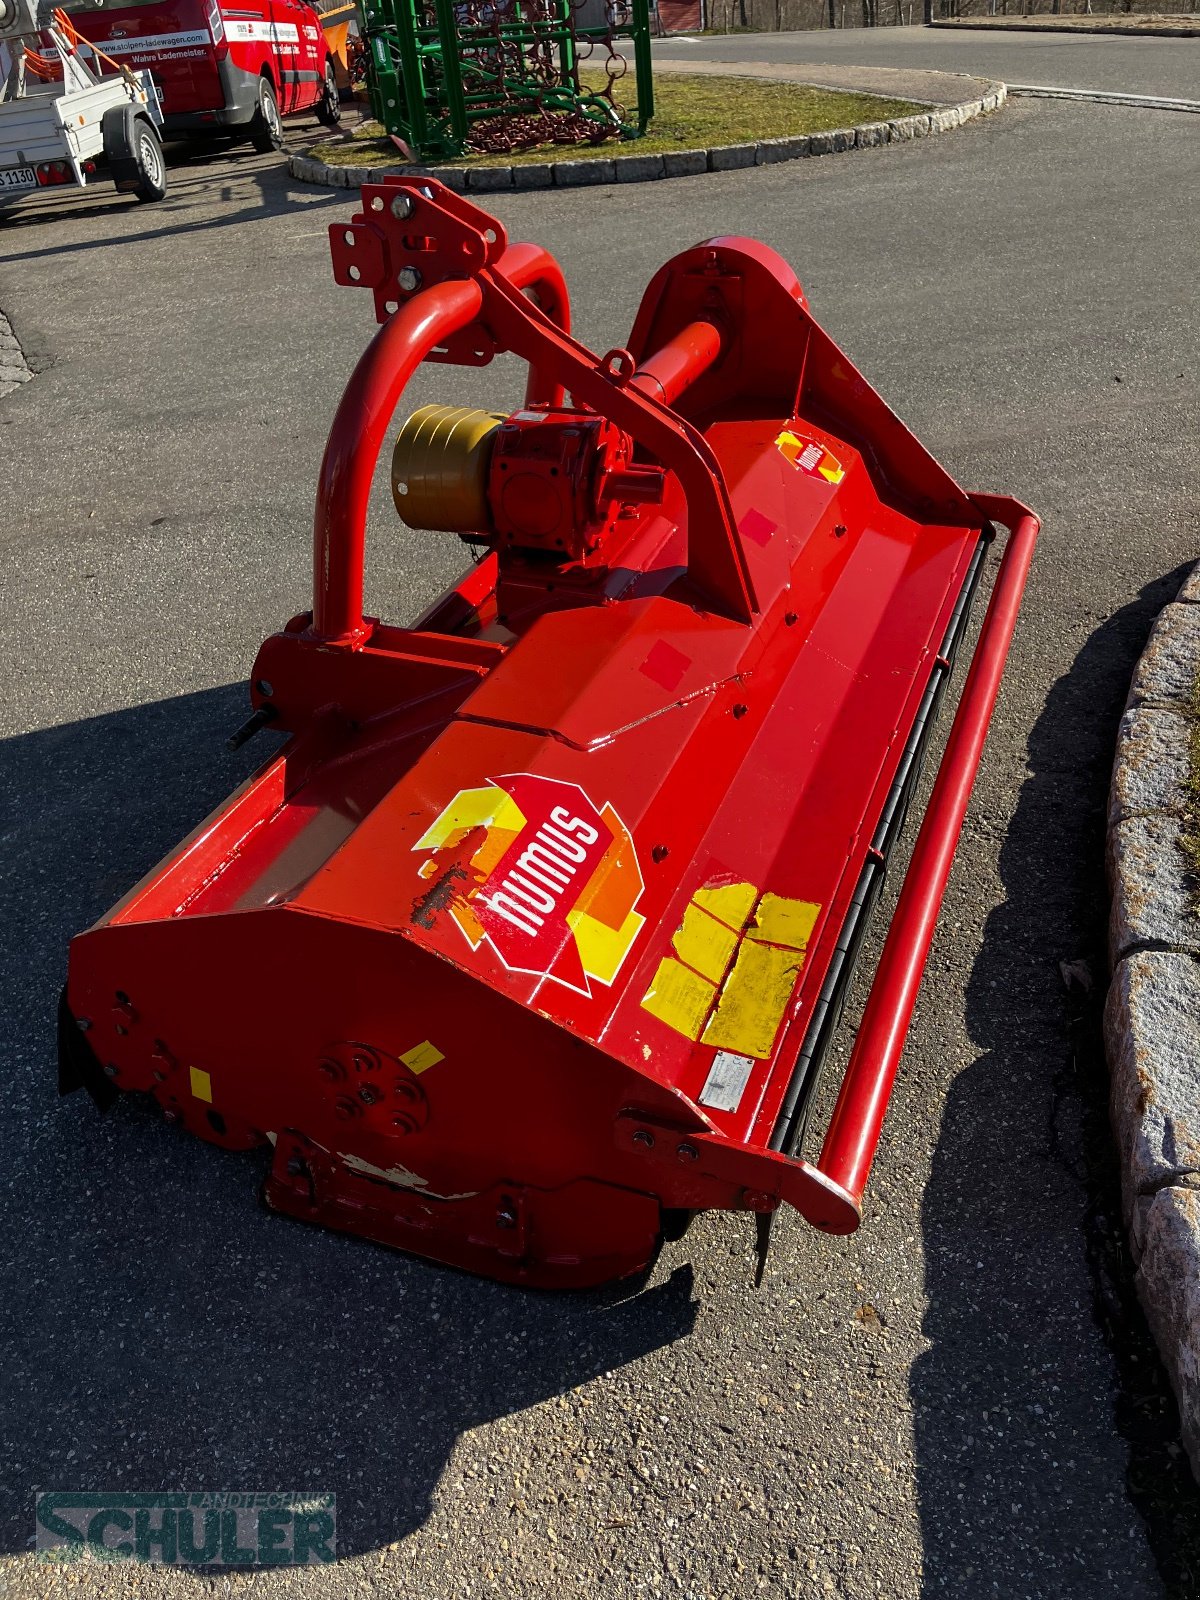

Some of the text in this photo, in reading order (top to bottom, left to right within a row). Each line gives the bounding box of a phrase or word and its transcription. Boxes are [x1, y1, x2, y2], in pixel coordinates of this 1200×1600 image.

[132, 49, 207, 63] Wahre Lademeister.
[6, 169, 34, 185] 1130
[475, 805, 599, 938] humus
